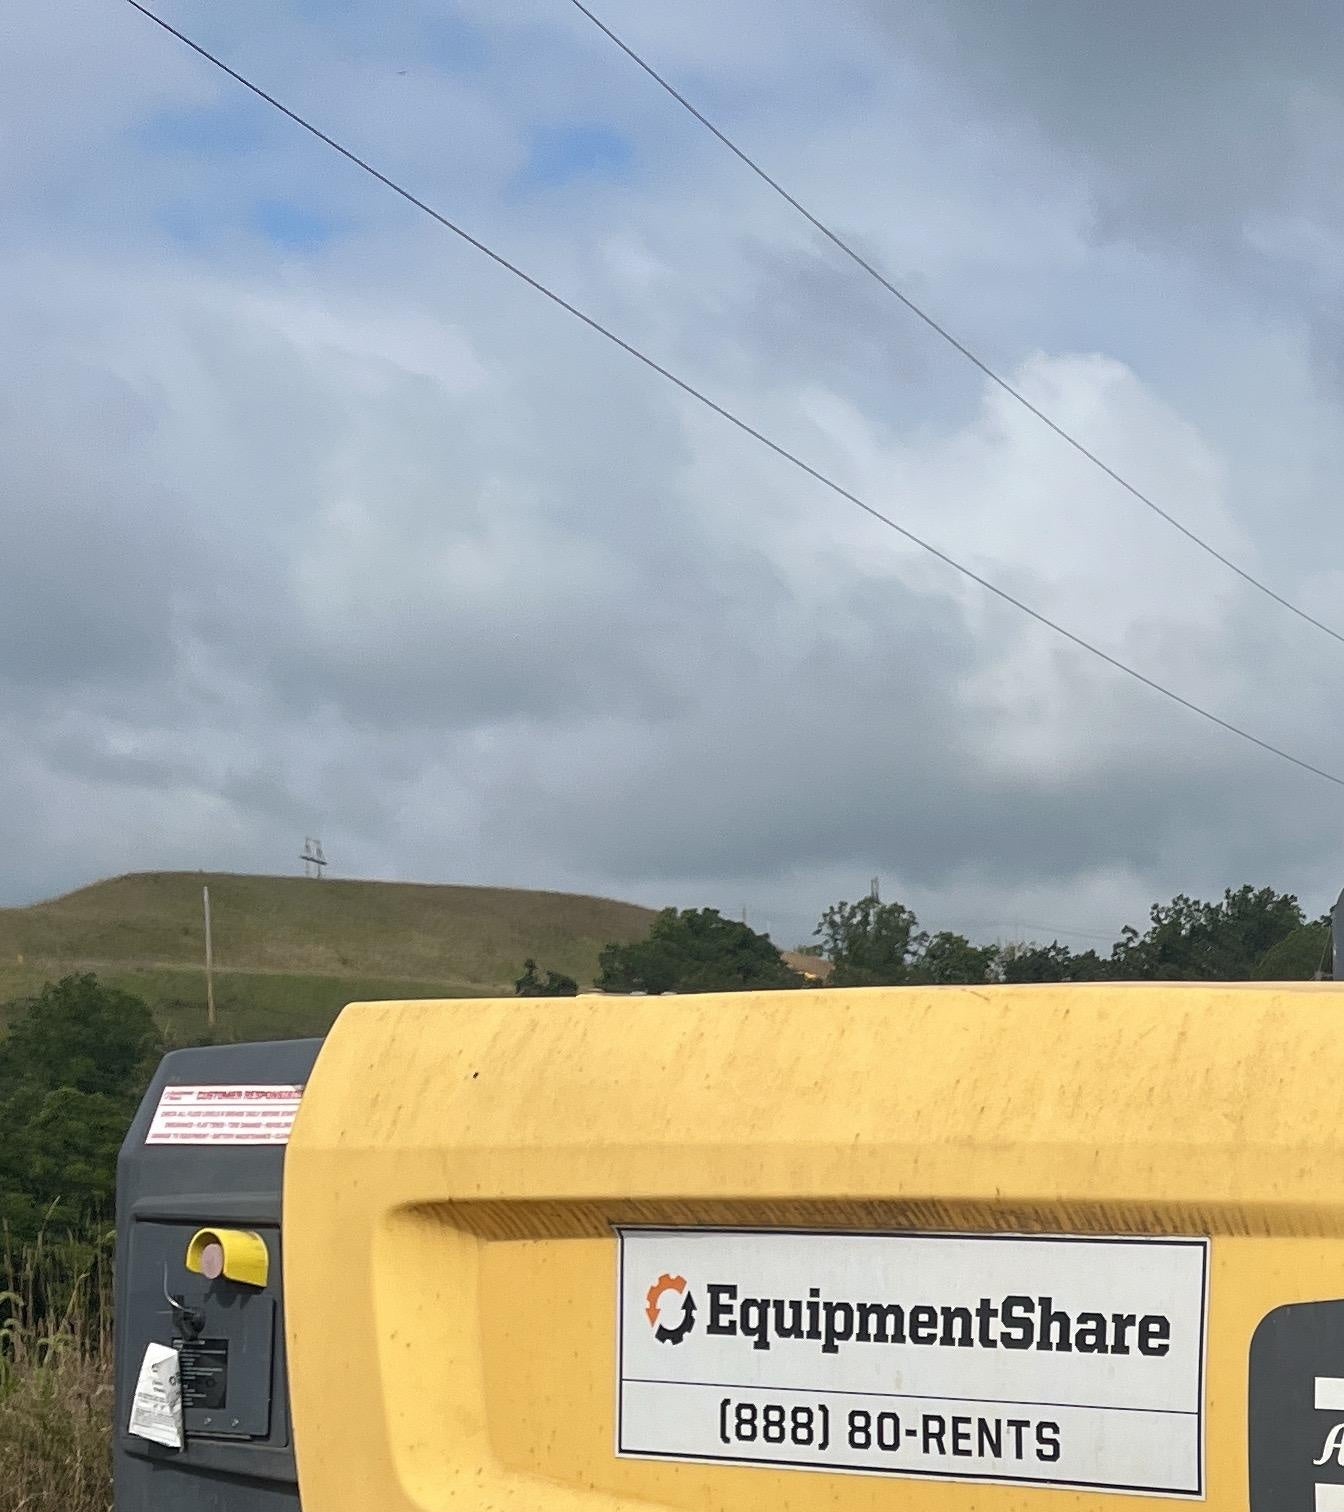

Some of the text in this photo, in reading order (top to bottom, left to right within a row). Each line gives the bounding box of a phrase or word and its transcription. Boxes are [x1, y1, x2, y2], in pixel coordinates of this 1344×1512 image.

[706, 1283, 1170, 1357] EquipmentShare
[719, 1398, 1062, 1463] (888) 80-RENTS
